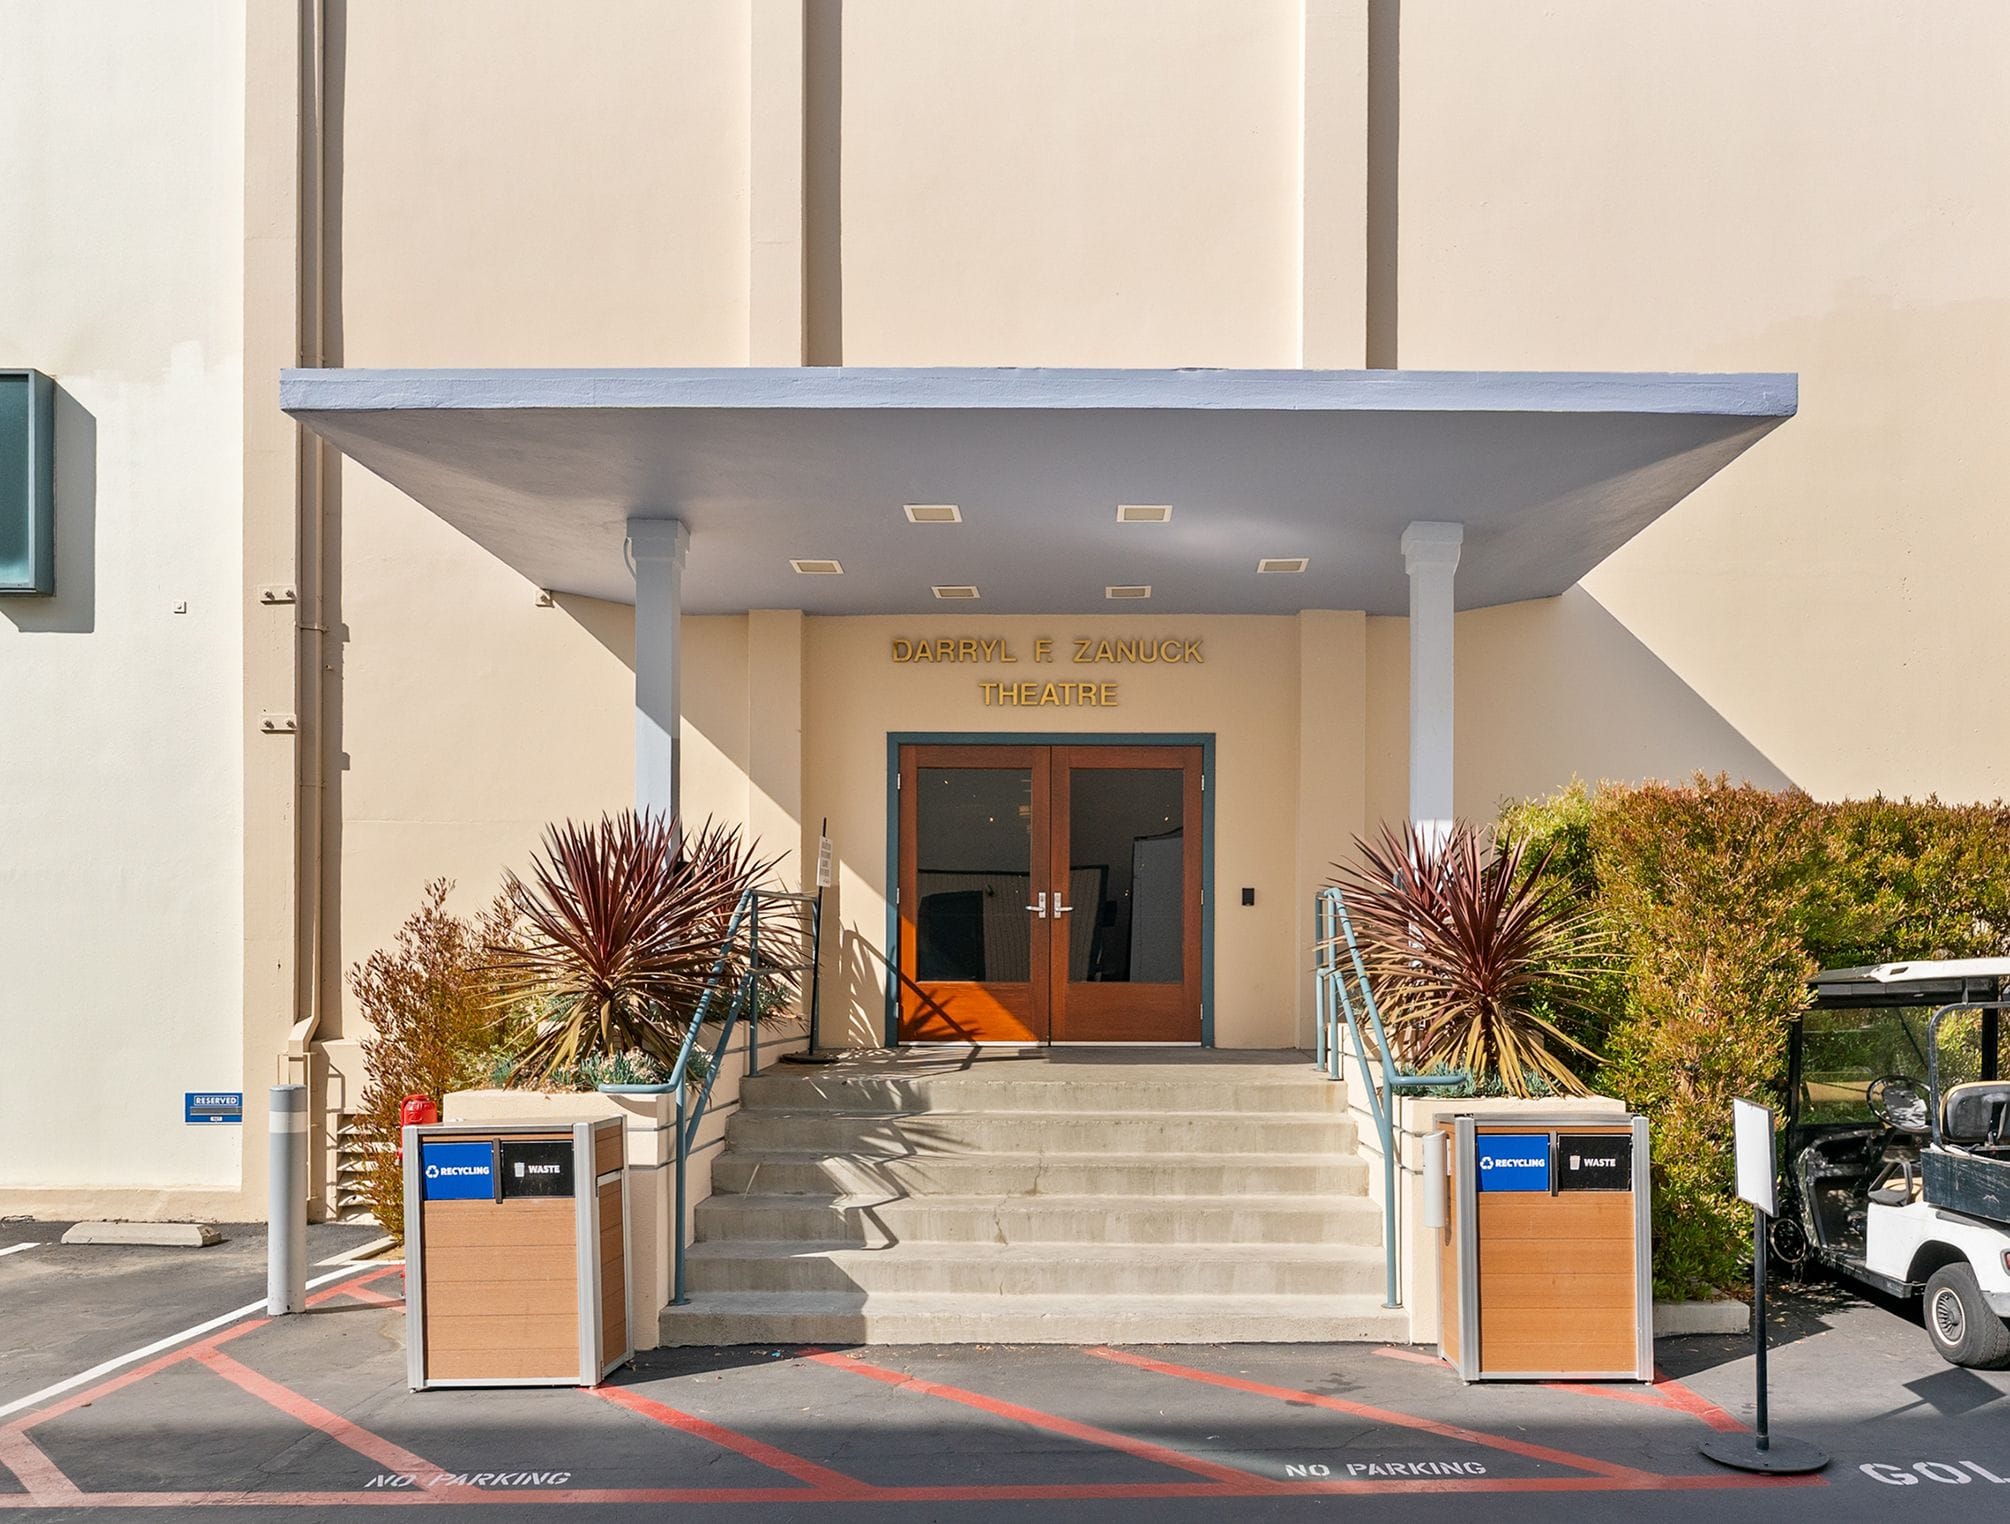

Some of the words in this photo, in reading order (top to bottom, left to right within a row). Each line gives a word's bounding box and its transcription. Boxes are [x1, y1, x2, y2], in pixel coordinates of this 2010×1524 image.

[892, 639, 1016, 663] DARRYL
[1073, 639, 1205, 663] ZANUCK
[980, 682, 1119, 706] THEATRE
[195, 1097, 237, 1105] RESERVED
[1495, 1158, 1545, 1168] RECYCLING
[1584, 1158, 1616, 1167] WASTE
[440, 1165, 490, 1176] RECYCLING
[528, 1164, 560, 1174] WASTE
[1285, 1464, 1331, 1477] NO
[1346, 1462, 1487, 1476] PARKING
[364, 1474, 417, 1488] NO
[428, 1472, 571, 1487] PARKING
